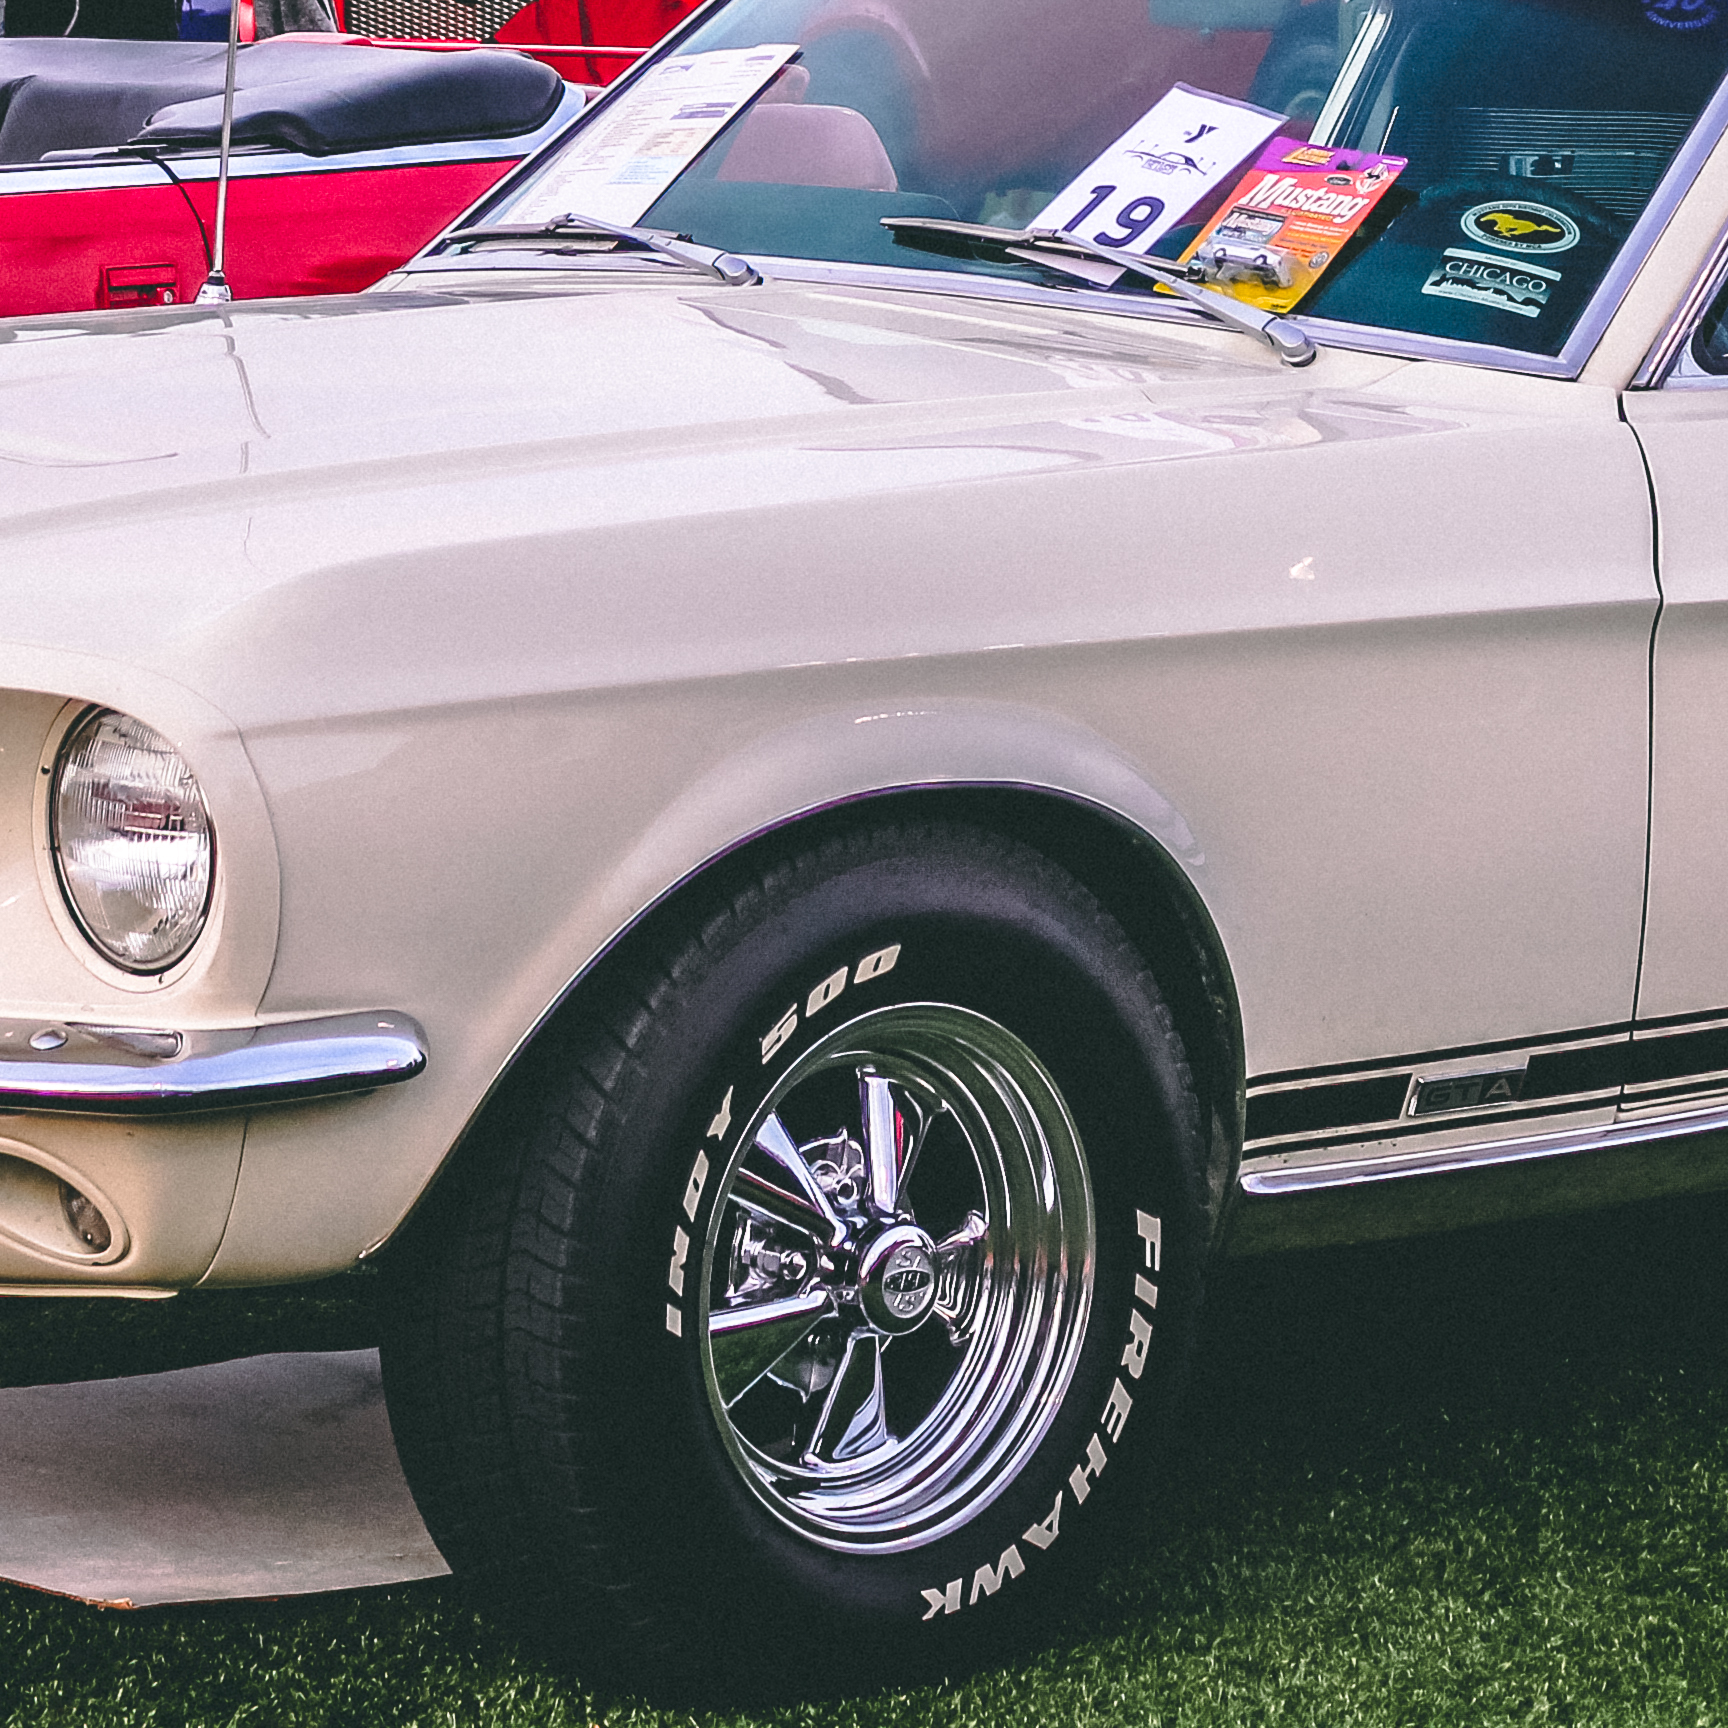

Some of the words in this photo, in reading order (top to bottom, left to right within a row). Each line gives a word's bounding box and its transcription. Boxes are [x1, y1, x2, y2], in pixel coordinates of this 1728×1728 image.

[1060, 184, 1166, 249] 19
[1237, 173, 1371, 224] Mustang
[1445, 261, 1547, 293] CHICAGO
[666, 1084, 735, 1338] INDY
[760, 943, 902, 1065] 500
[920, 1209, 1162, 1621] FIREHAWK
